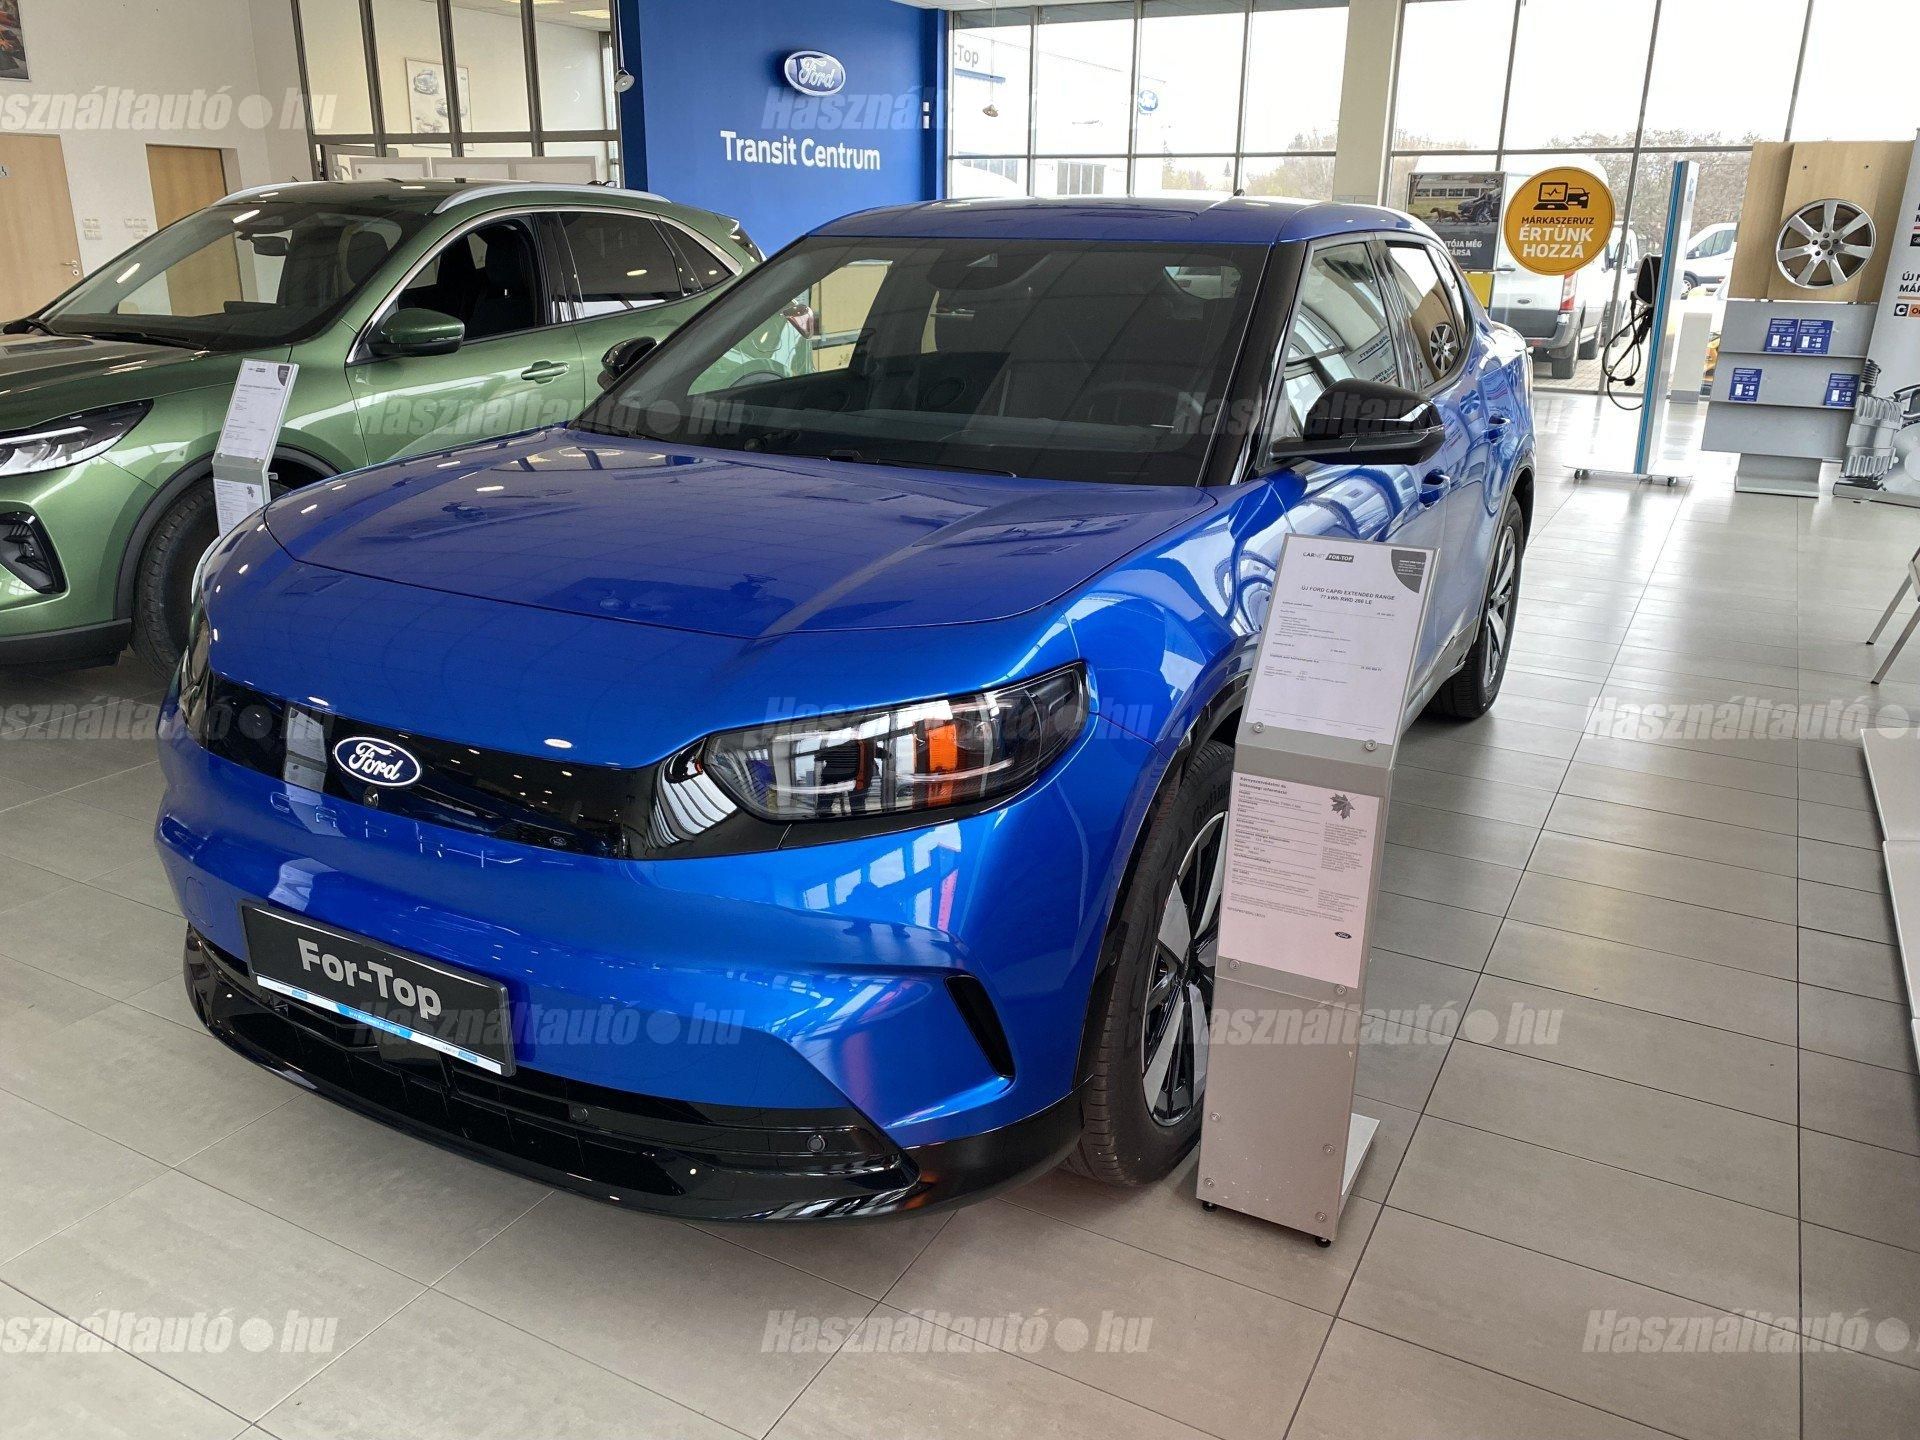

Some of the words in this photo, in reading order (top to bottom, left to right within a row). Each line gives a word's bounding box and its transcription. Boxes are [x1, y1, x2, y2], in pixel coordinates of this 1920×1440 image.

[720, 130, 797, 166] Transit
[801, 138, 880, 171] Centrum
[1521, 216, 1595, 225] MÁRKASZERVIZ
[1519, 224, 1595, 242] ÉRTÜNK
[1465, 239, 1482, 248] MÉG
[1522, 242, 1584, 259] HOZZÁ
[1902, 270, 1914, 281] ÚJ
[1344, 590, 1374, 598] EXTENDED
[348, 741, 404, 781] Ford
[297, 938, 442, 1020] For-Top
